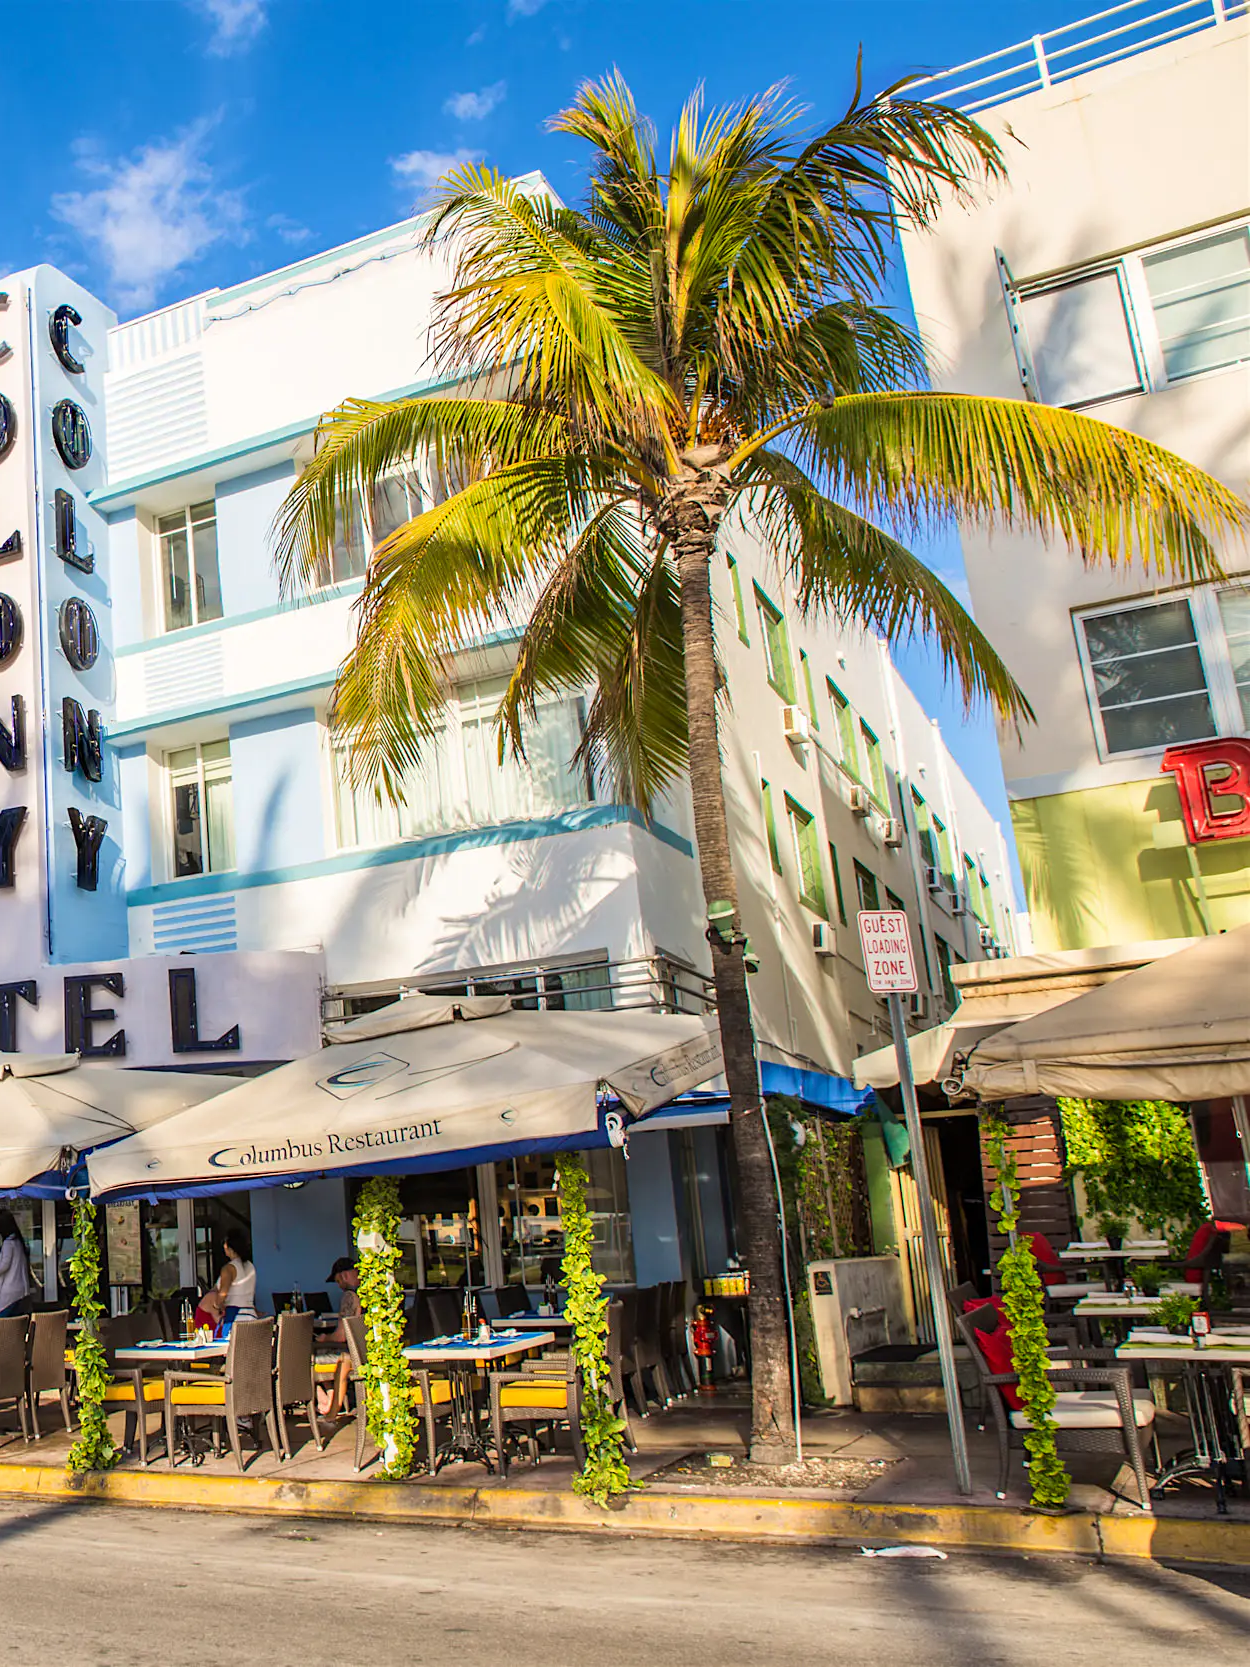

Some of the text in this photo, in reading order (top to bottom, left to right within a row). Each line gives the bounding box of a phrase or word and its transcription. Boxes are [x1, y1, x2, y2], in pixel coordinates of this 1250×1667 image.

[50, 302, 108, 893] COLONY
[863, 918, 902, 933] GUEST
[865, 939, 907, 954] LOADING
[873, 960, 908, 976] ZONE
[207, 1119, 443, 1168] Columbus Restaurant
